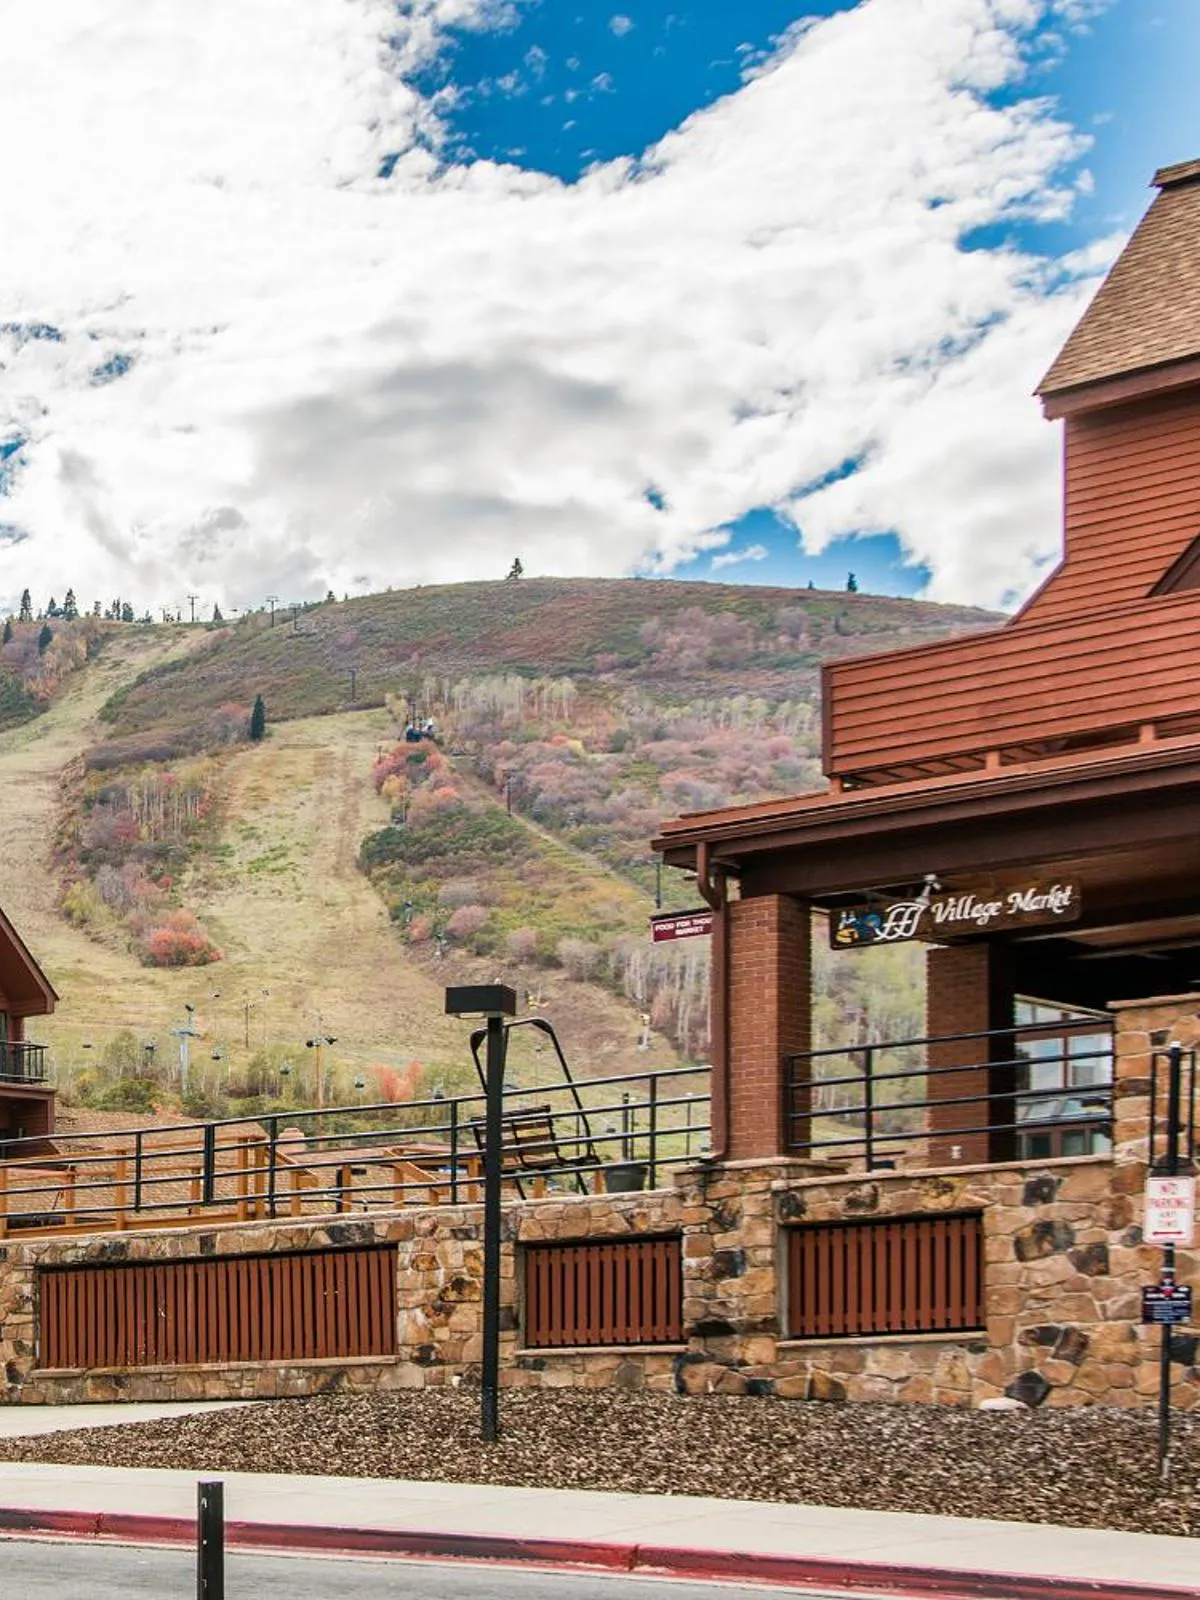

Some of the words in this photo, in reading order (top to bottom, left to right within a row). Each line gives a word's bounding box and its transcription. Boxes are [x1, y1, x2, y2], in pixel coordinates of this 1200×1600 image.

[930, 896, 1002, 925] Village
[1007, 884, 1072, 913] Market
[655, 923, 675, 931] FOOD
[676, 920, 691, 928] FOR
[675, 926, 704, 935] MARKET
